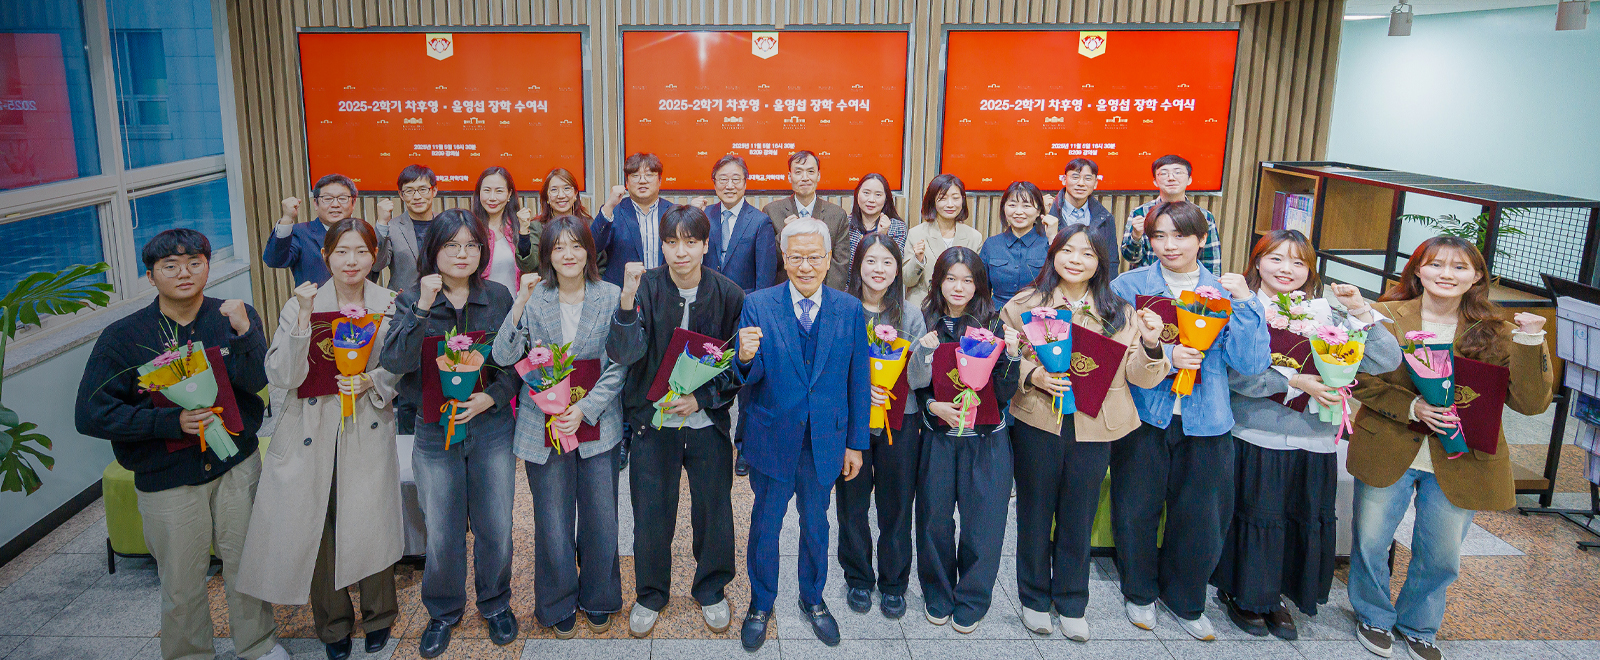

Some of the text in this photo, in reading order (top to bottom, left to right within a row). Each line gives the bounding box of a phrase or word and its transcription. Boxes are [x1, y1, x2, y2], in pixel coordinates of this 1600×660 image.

[338, 100, 402, 113] 2025-2학기
[405, 100, 439, 113] 차후영
[451, 100, 485, 113] 윤영섭
[488, 100, 512, 113] 장학
[514, 100, 548, 113] 수여식
[658, 99, 723, 112] 2025-2학기
[725, 99, 760, 112] 차후영
[773, 99, 807, 112] 윤영섭
[809, 99, 834, 112] 장학
[836, 99, 870, 112] 수여식
[979, 99, 1045, 112] 2025-2학기
[1048, 99, 1083, 112] 차후영
[1095, 99, 1130, 112] 윤영섭
[1133, 99, 1158, 112] 장학
[1160, 99, 1196, 112] 수여식
